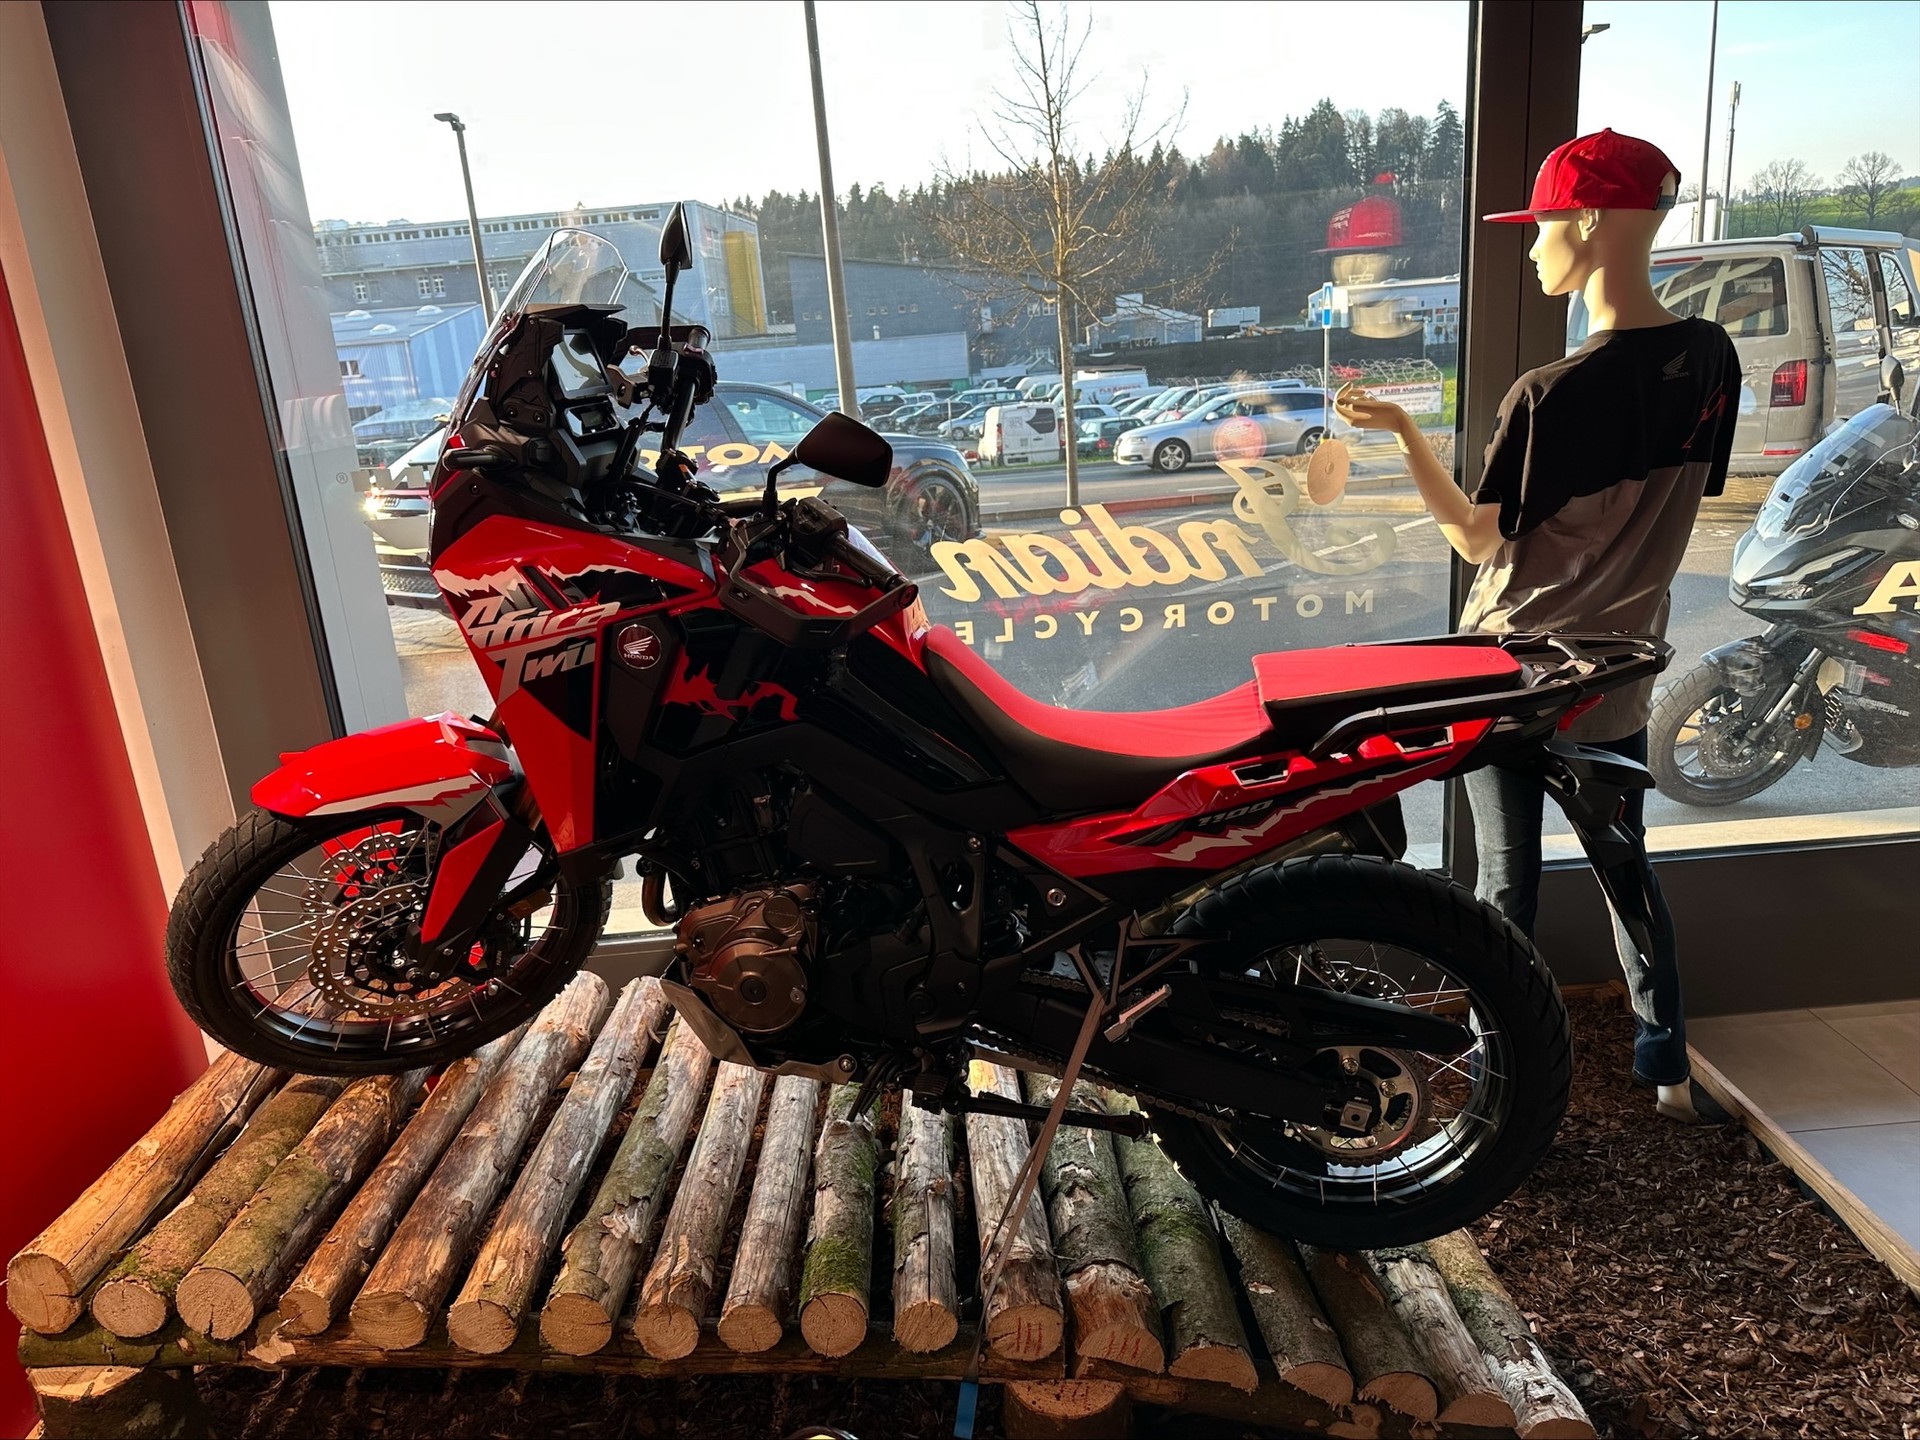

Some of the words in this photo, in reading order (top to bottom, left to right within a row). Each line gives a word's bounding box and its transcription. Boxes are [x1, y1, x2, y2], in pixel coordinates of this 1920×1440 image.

[460, 595, 621, 649] Africa
[622, 652, 655, 662] HONDA
[1198, 799, 1275, 827] 1100
